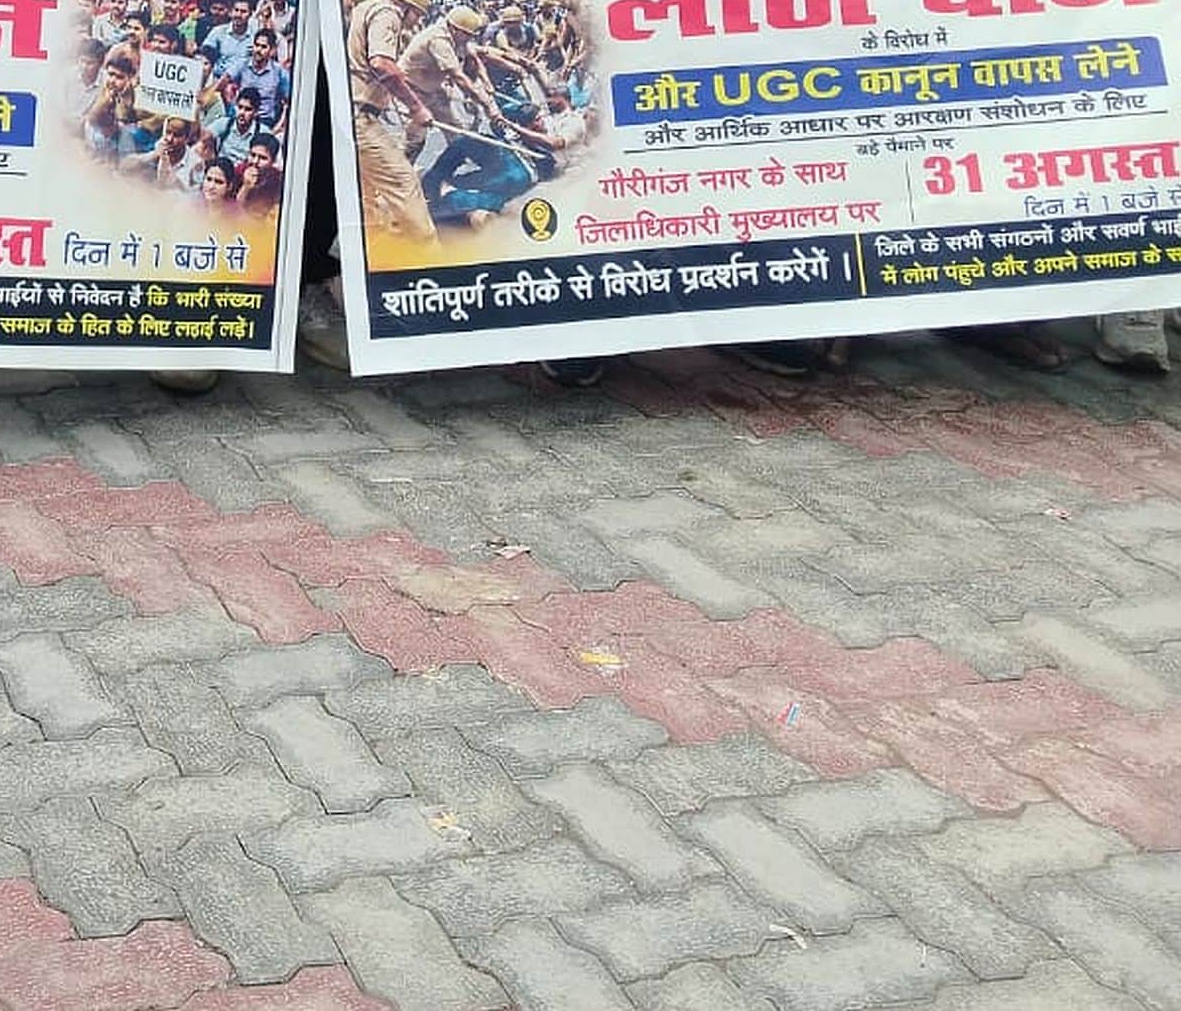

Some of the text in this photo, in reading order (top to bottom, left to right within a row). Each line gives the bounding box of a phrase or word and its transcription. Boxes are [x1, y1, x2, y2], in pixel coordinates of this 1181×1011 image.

[861, 28, 929, 50] के विरोध
[154, 61, 188, 83] UGC
[633, 42, 1141, 111] और UGC कानून वापस लेने
[644, 90, 1148, 146] और आर्थिक आधार पर आरक्षण के लिए
[932, 138, 955, 150] पर
[598, 157, 849, 200] गौरीगंज नगर के साथ
[923, 140, 1180, 196] 31 अगस्त
[1024, 195, 1063, 218] दिन
[1120, 185, 1158, 209] बजे
[575, 200, 883, 246] जिलाधिकारी मुख्यालय पर
[875, 215, 1149, 257] जिले के सभी और सवर्ण
[63, 235, 109, 266] दिन
[121, 232, 142, 266] में
[174, 234, 217, 271] बजे
[225, 237, 249, 271] से
[902, 261, 939, 285] लोग
[991, 255, 1028, 278] और
[1034, 250, 1078, 276] अपने
[1082, 251, 1137, 271] समाज
[1141, 243, 1162, 264] के
[48, 286, 64, 307] से
[71, 285, 123, 307] निवेदन
[129, 285, 143, 307] है
[146, 285, 169, 307] कि
[175, 287, 210, 308] भारी
[214, 287, 263, 310] संख्या
[382, 251, 759, 320] शांतिपूर्ण तरीके से विरोध प्रदर्शन
[0, 315, 51, 334] समाज
[56, 312, 76, 334] के
[82, 314, 111, 338] हित
[117, 313, 134, 335] के
[139, 314, 171, 337] लिए
